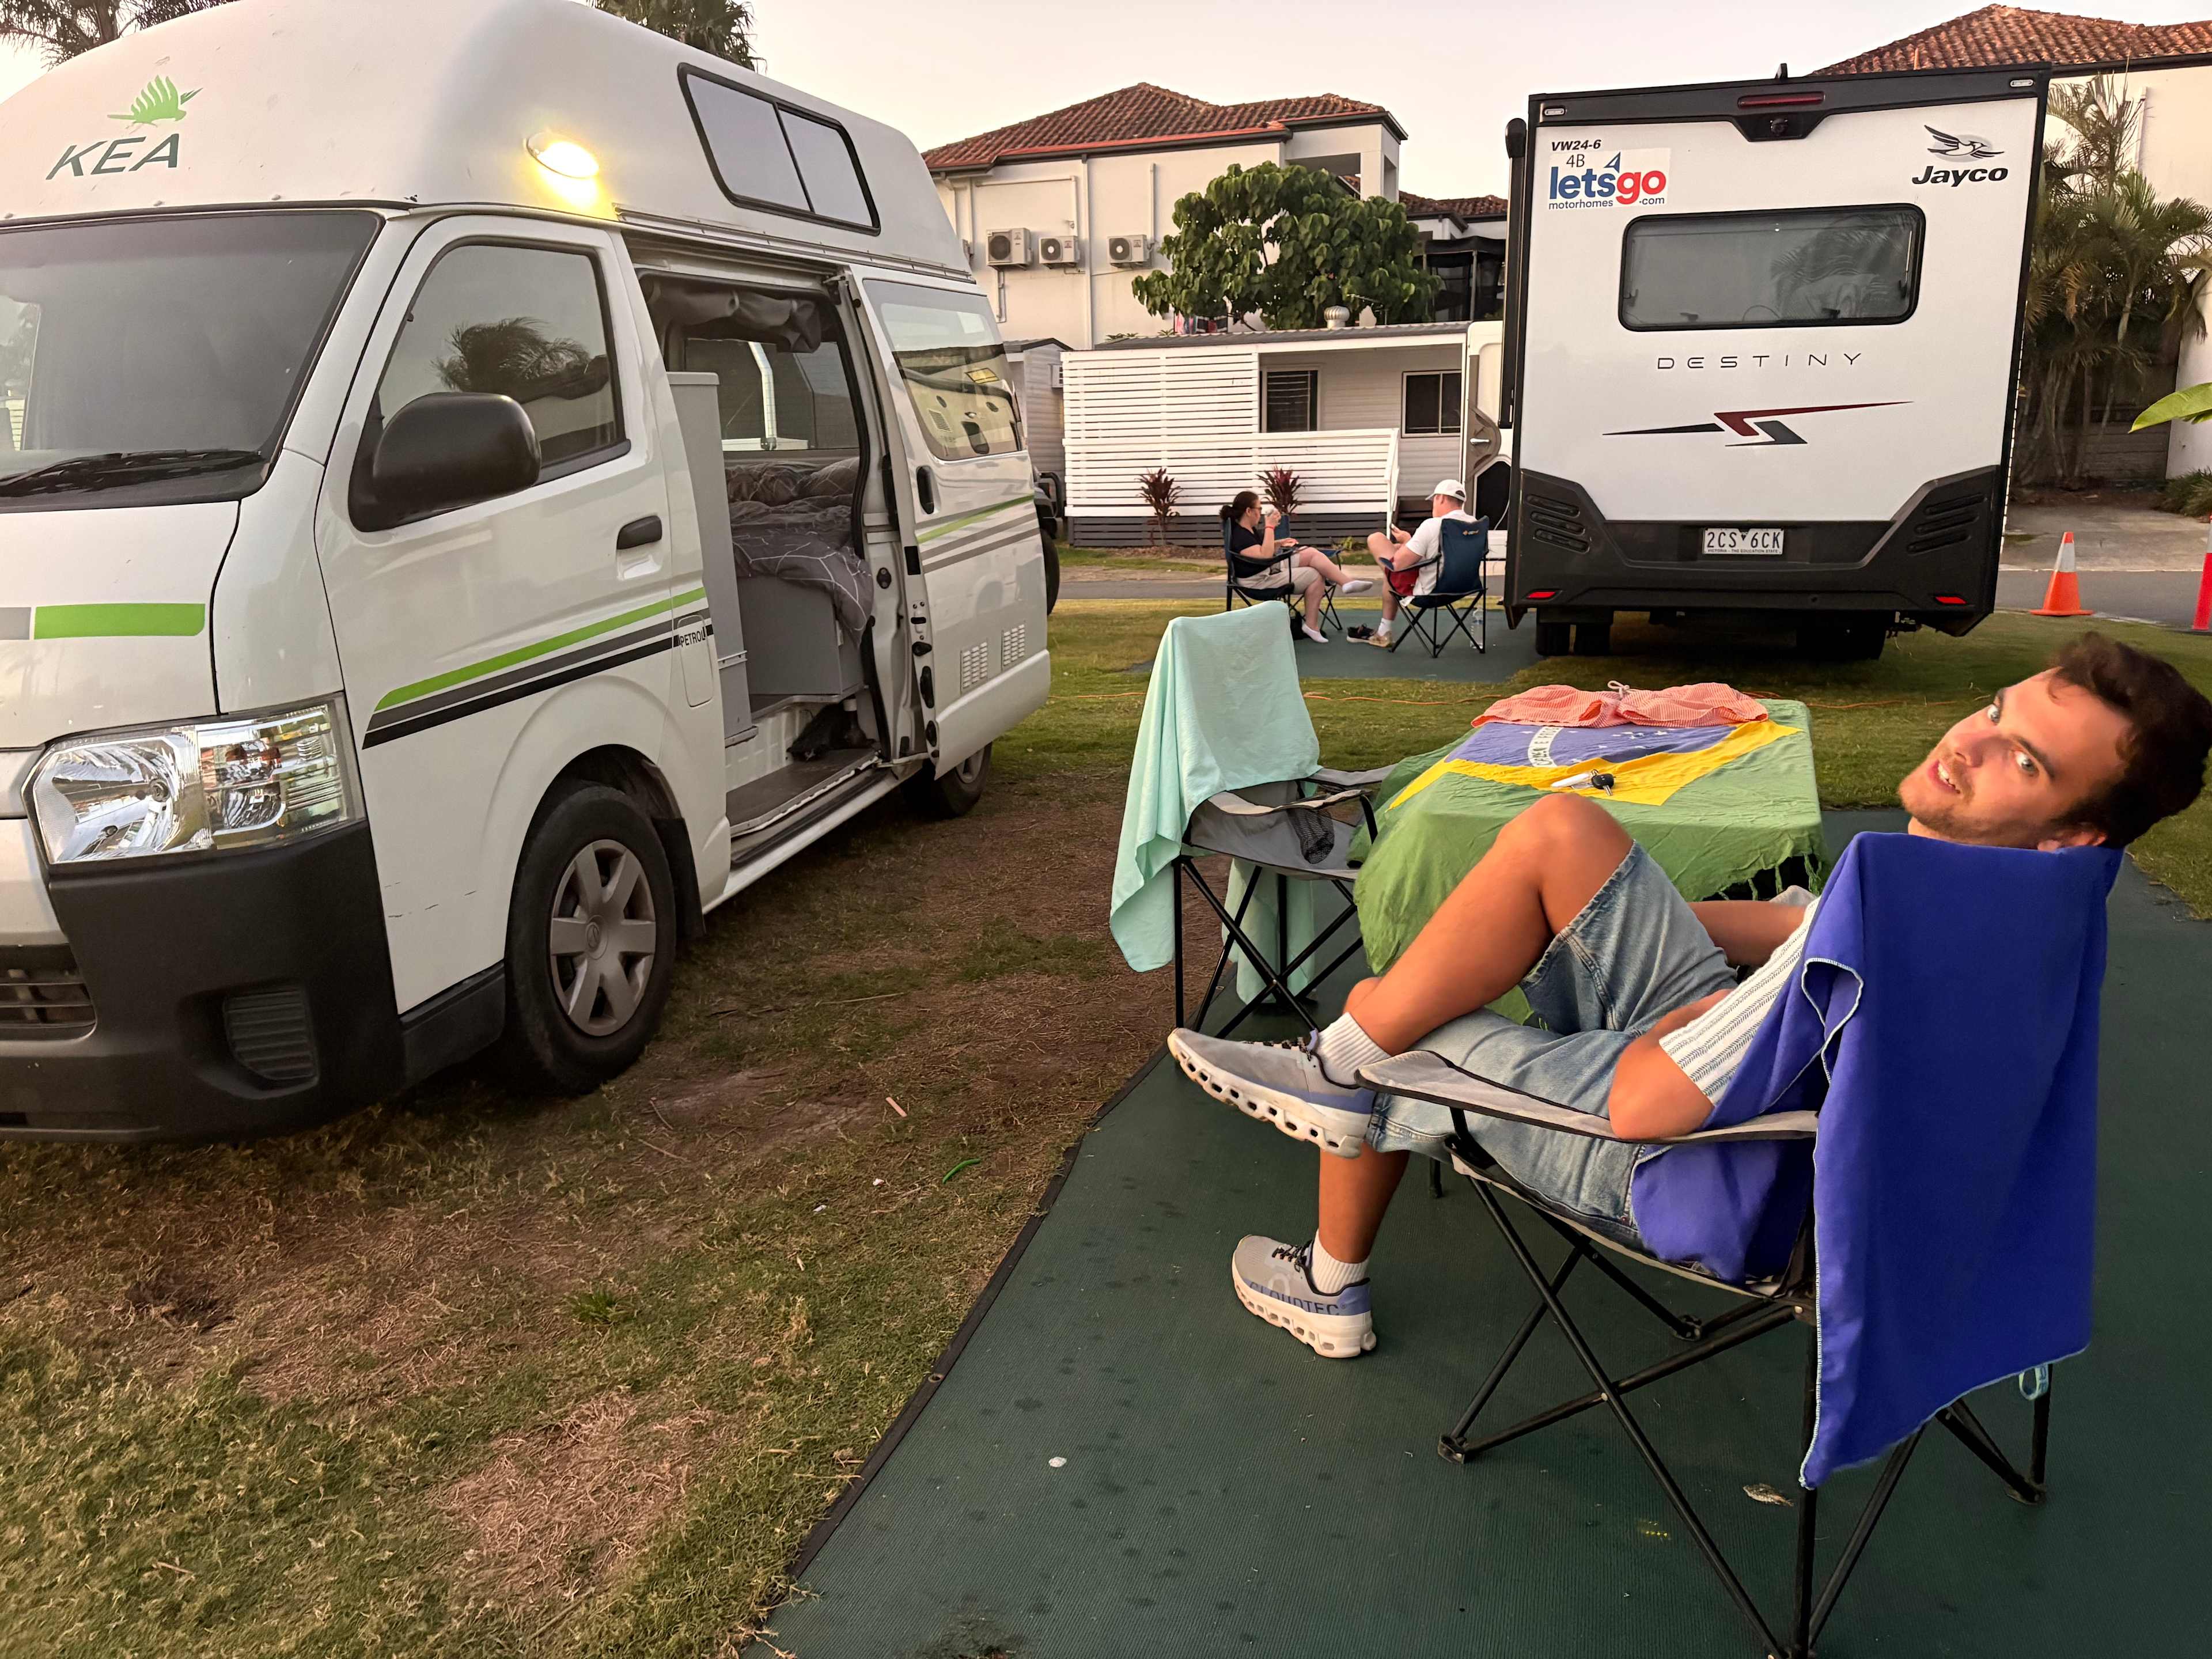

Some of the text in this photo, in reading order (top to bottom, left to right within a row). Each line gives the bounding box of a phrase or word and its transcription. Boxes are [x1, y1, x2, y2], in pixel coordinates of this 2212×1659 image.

[1551, 139, 1602, 151] VW24-6
[46, 133, 179, 180] KEA
[1566, 154, 1585, 168] 4B
[1912, 165, 2009, 187] Jayco
[1549, 197, 1665, 210] motorhomes .com
[1657, 353, 1861, 369] DESTINY
[1707, 532, 1780, 548] 2CS 6CK
[680, 629, 706, 647] PETROL
